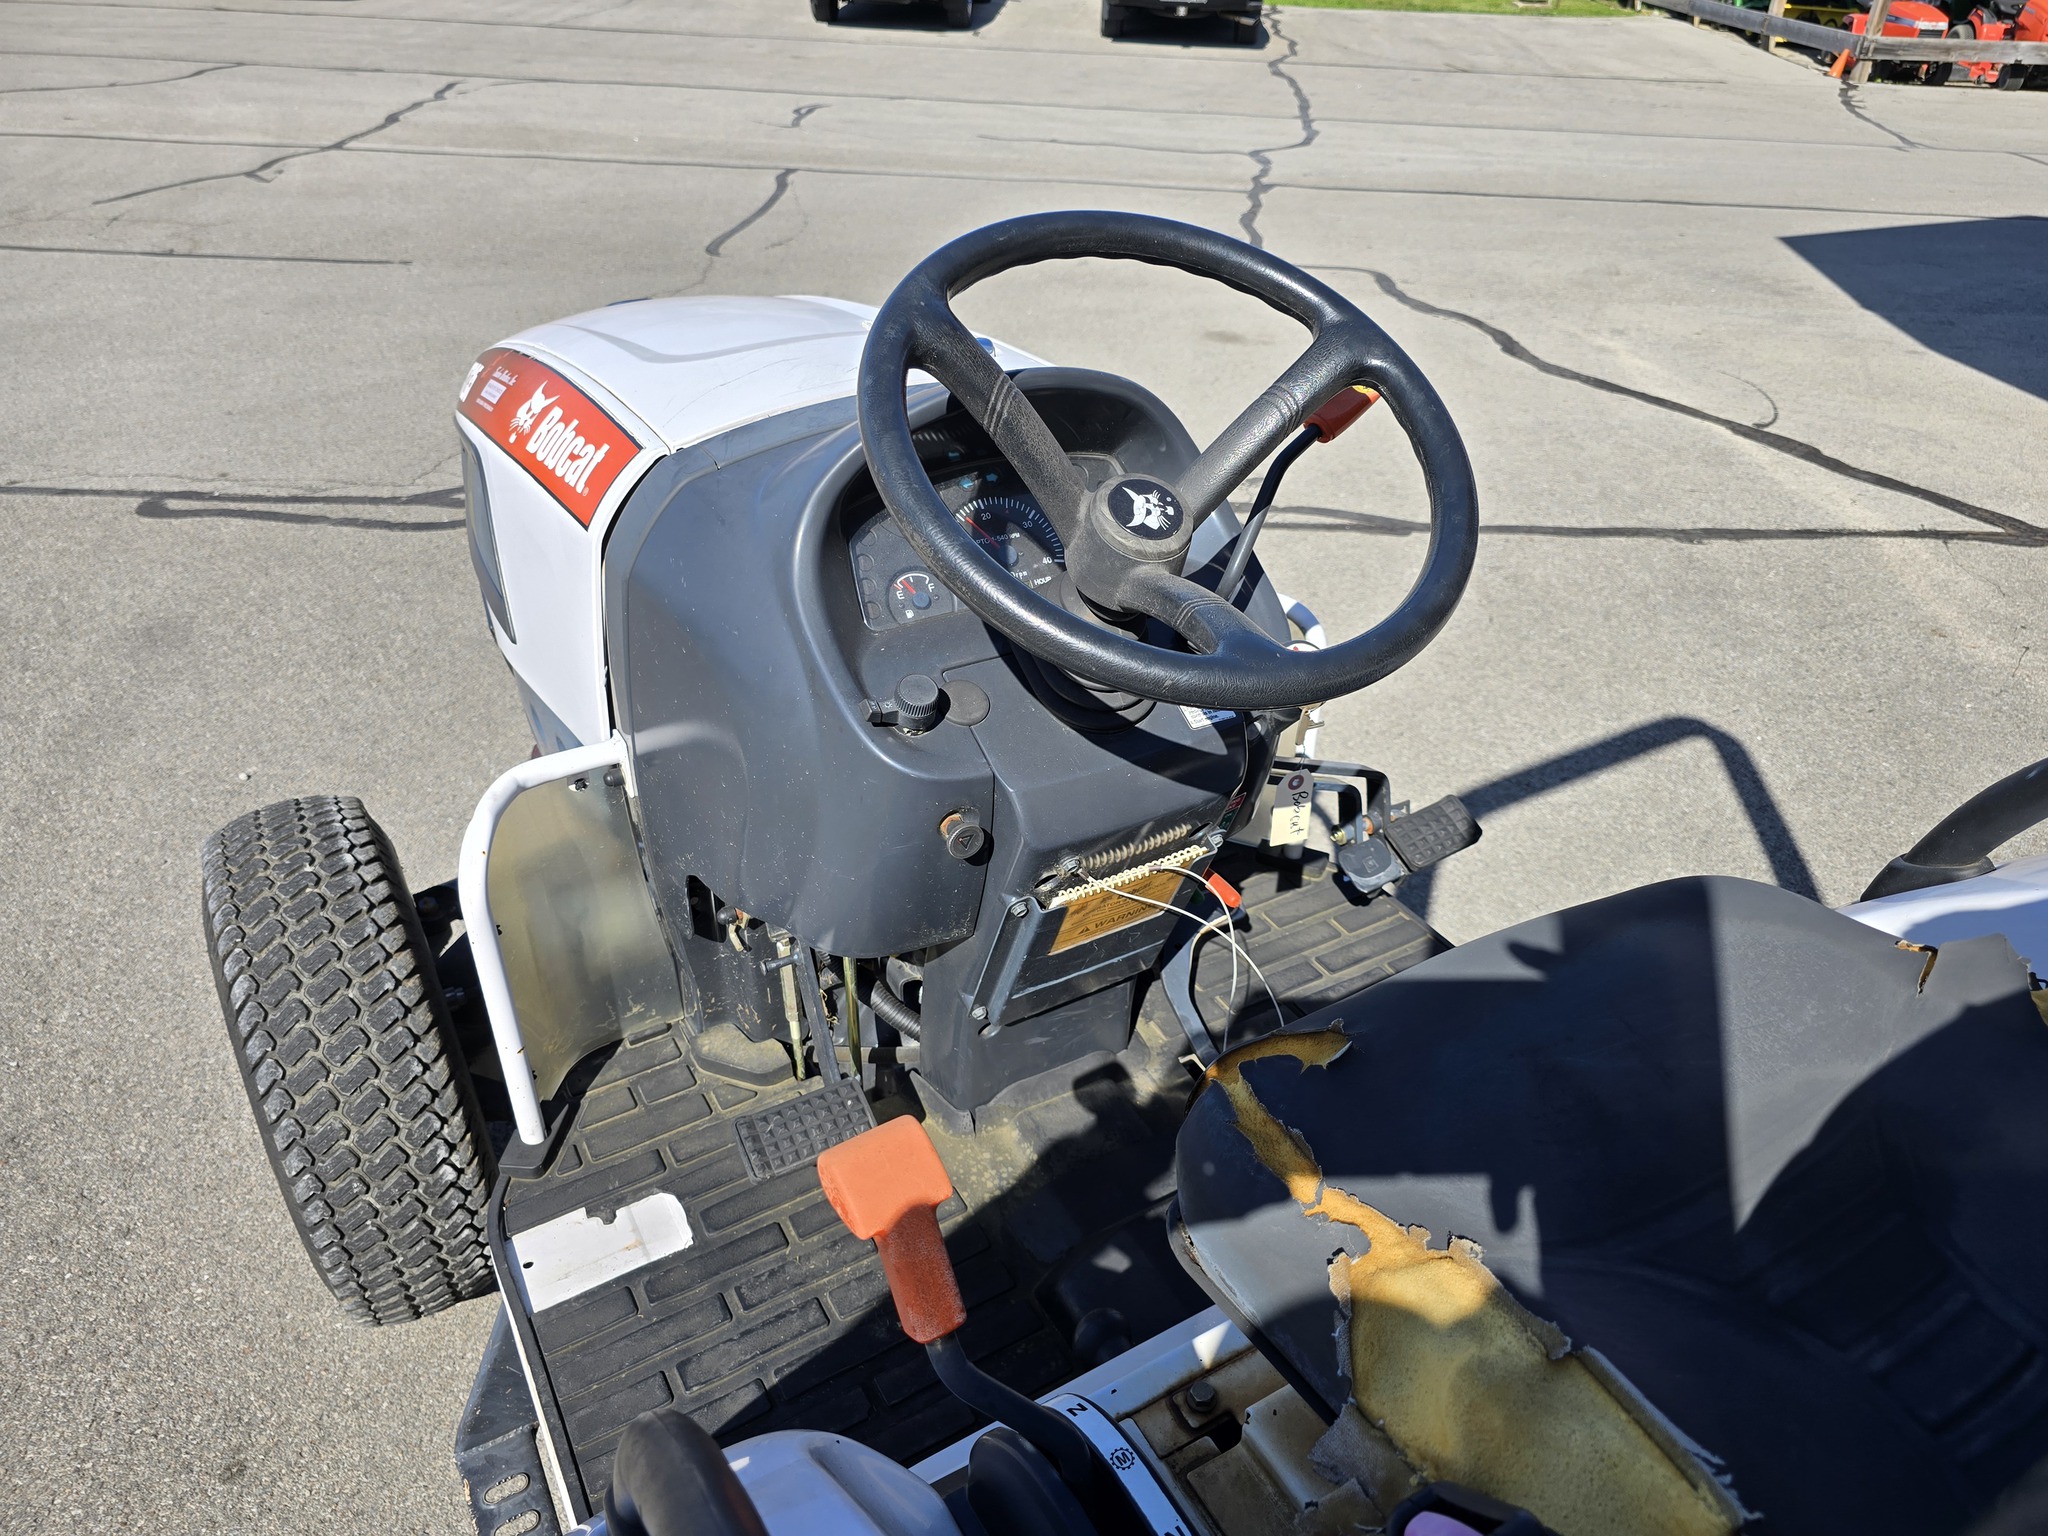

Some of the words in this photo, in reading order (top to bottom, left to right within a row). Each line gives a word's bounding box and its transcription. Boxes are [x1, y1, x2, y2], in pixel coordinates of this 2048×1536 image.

[525, 405, 610, 494] Bobcat
[980, 512, 992, 521] 20
[1022, 520, 1033, 529] 30
[1042, 556, 1053, 565] 40
[927, 582, 935, 593] F
[896, 590, 905, 600] E
